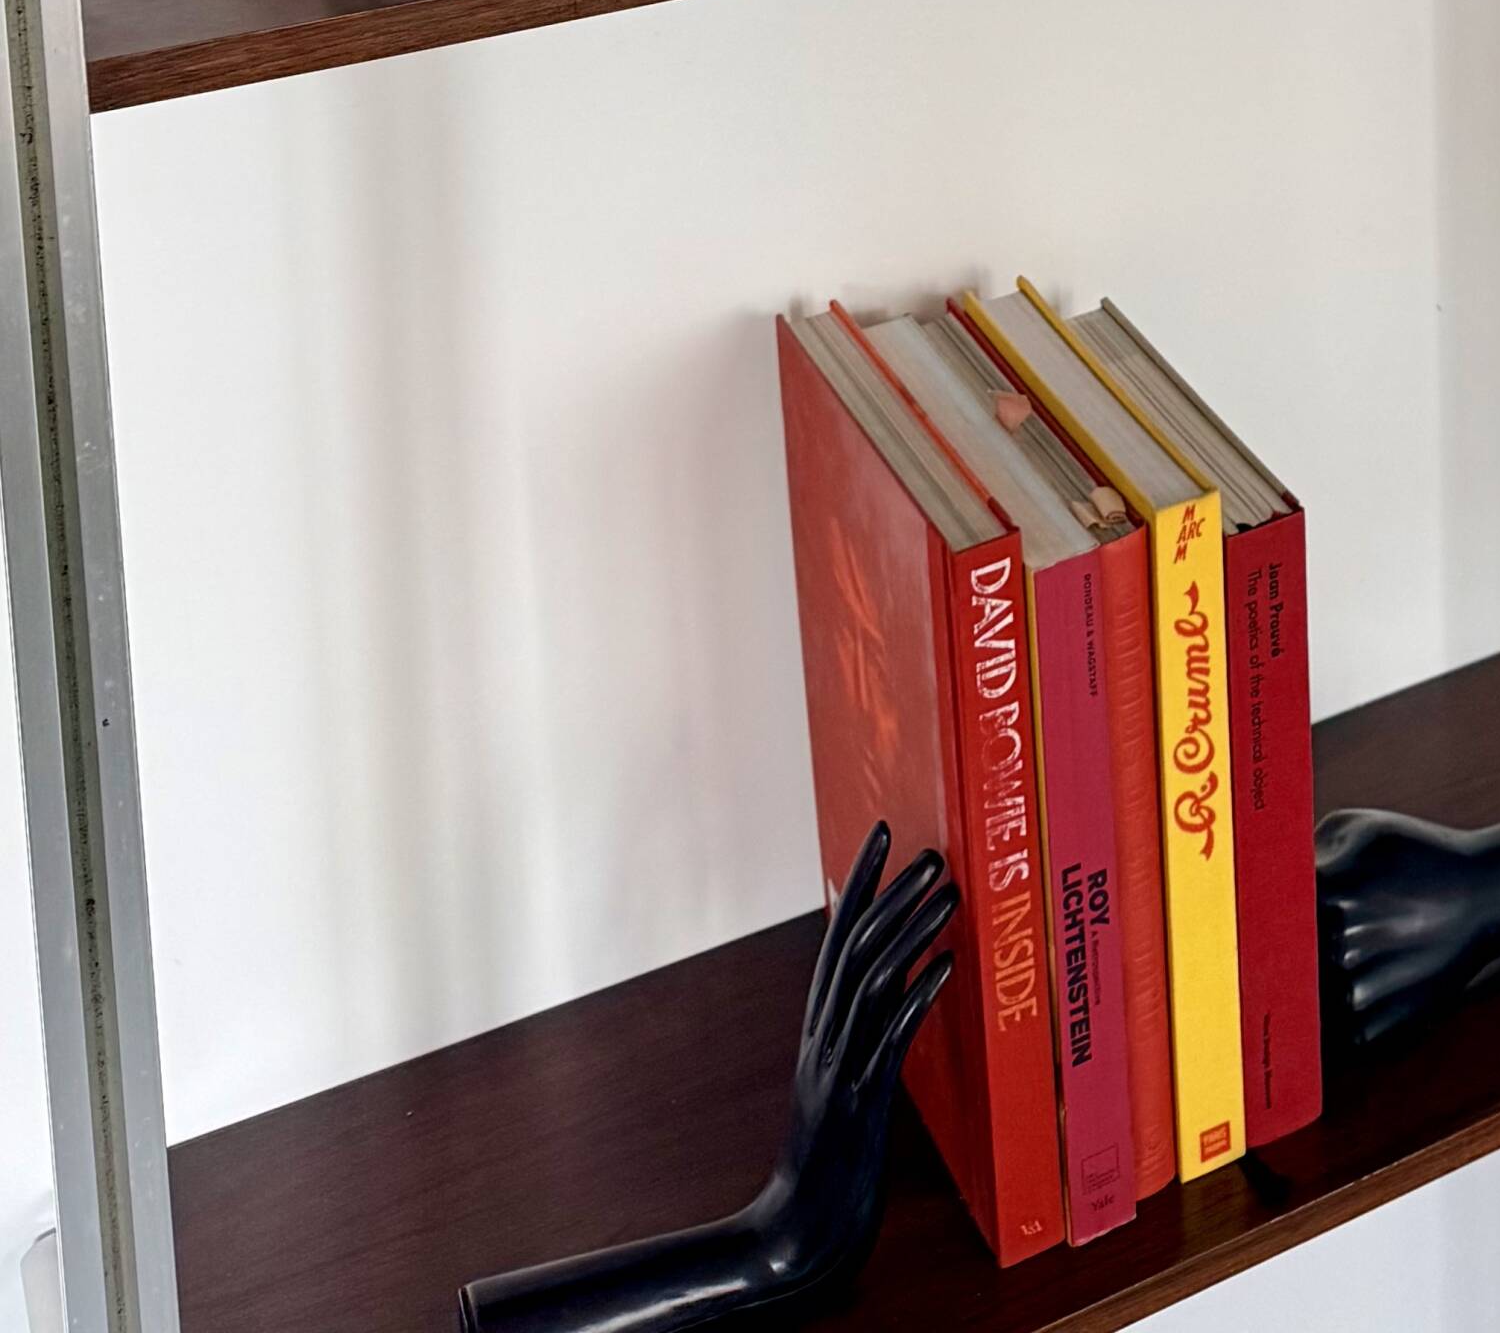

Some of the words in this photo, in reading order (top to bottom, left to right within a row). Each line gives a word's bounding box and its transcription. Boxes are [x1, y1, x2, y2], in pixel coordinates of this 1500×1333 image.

[1083, 572, 1096, 628] RONDEAU
[1247, 567, 1262, 597] The
[1268, 562, 1282, 601] Jean
[970, 556, 1018, 699] DAVID
[1245, 599, 1263, 652] poetics
[1086, 640, 1099, 698] WAGSTAFF
[1173, 580, 1216, 775] Crumb
[1249, 653, 1265, 671] of
[1249, 674, 1266, 698] the
[1251, 701, 1267, 765] technical
[979, 701, 1029, 853] BOWIE
[1249, 766, 1267, 812] object
[988, 848, 1030, 893] IS
[1086, 868, 1110, 926] ROY
[991, 891, 1038, 1033] INSIDE
[1060, 863, 1093, 1068] LICHTENSTEIN
